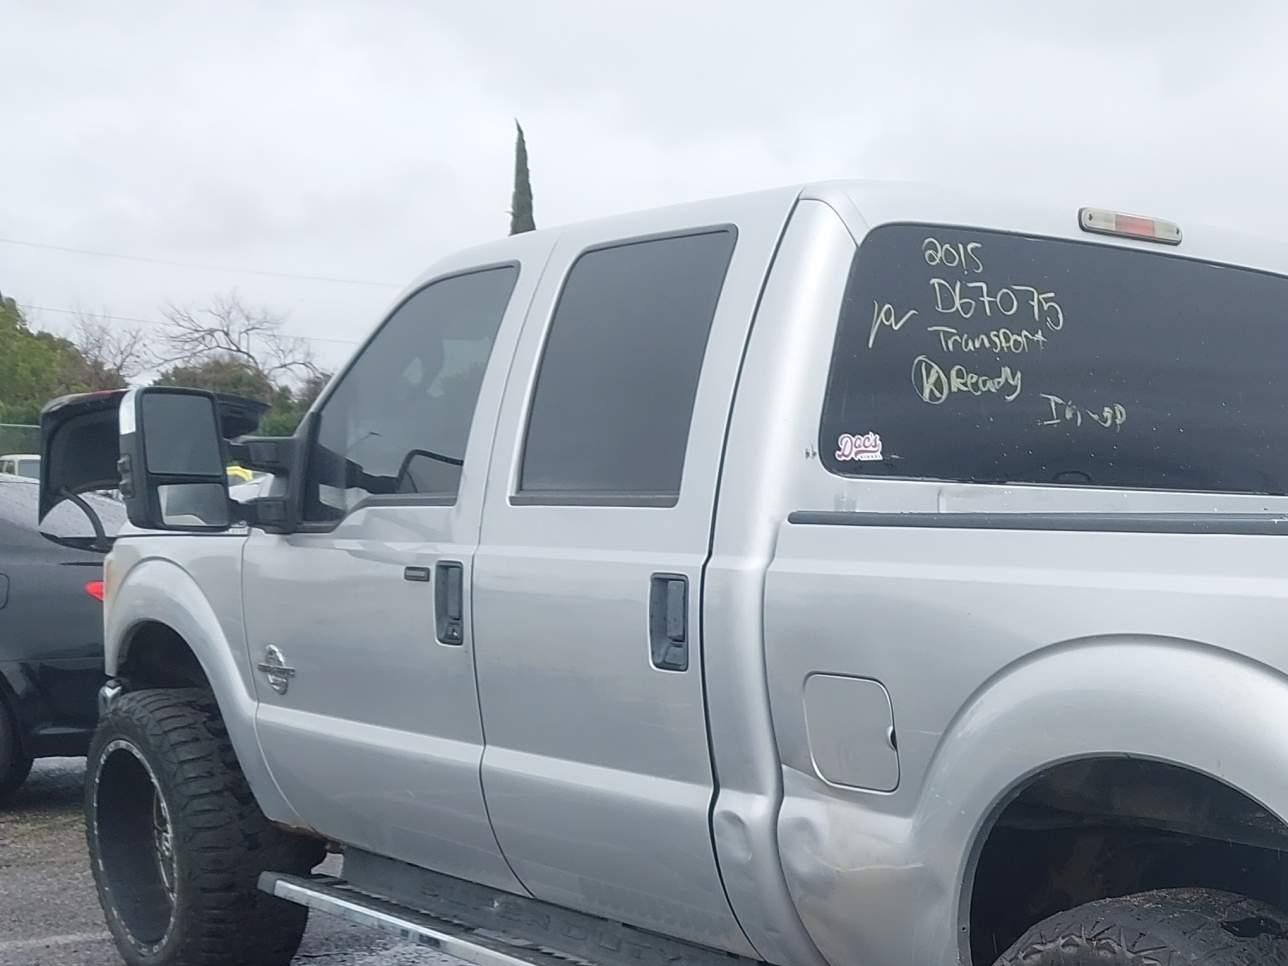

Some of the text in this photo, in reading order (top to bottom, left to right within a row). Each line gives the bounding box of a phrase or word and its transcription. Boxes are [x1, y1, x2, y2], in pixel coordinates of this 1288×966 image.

[923, 238, 983, 274] 2015
[930, 278, 1063, 330] D67075
[928, 326, 1047, 352] Transport
[950, 365, 1021, 401] Ready
